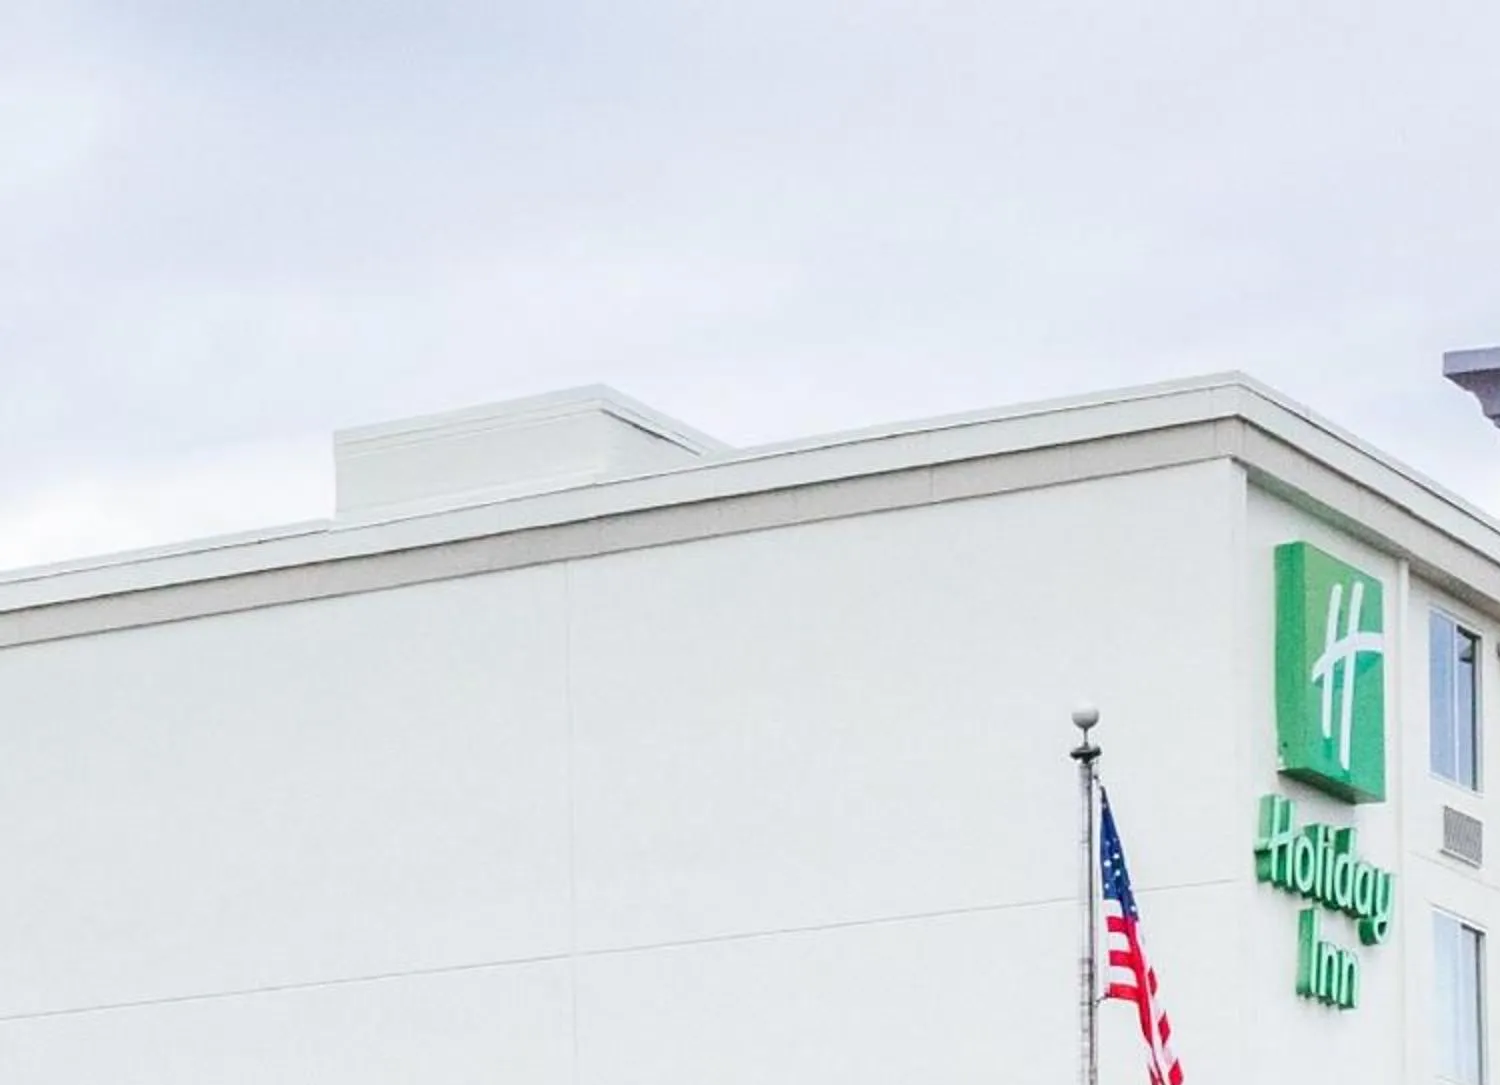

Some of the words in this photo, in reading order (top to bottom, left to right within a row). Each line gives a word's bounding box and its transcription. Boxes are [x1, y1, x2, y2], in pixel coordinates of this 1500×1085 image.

[1311, 580, 1385, 771] H
[1256, 795, 1394, 944] Holiday
[1298, 907, 1359, 1009] Inn
